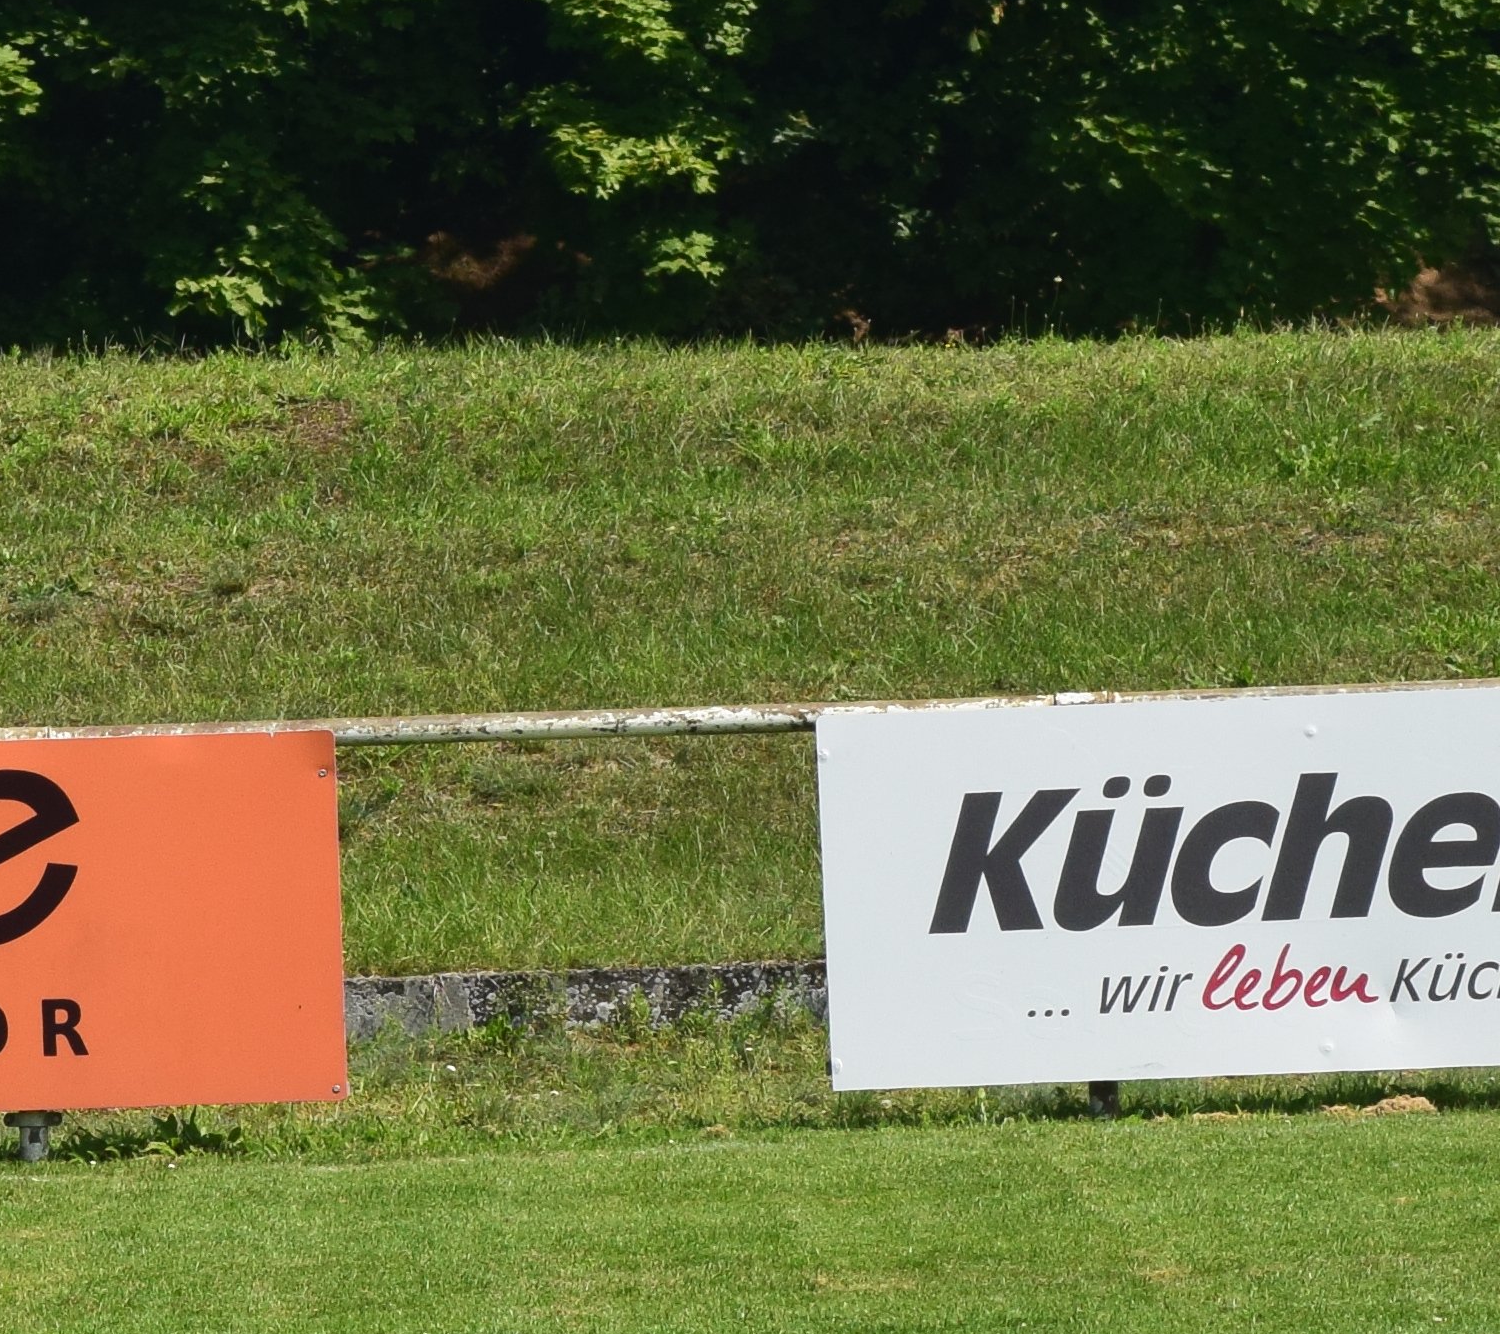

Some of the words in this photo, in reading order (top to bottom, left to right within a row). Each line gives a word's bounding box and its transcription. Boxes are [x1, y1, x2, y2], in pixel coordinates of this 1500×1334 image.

[928, 772, 1500, 934] Küche
[1099, 965, 1192, 1014] wir
[1201, 943, 1379, 1012] leben
[1389, 952, 1500, 1002] Küc
